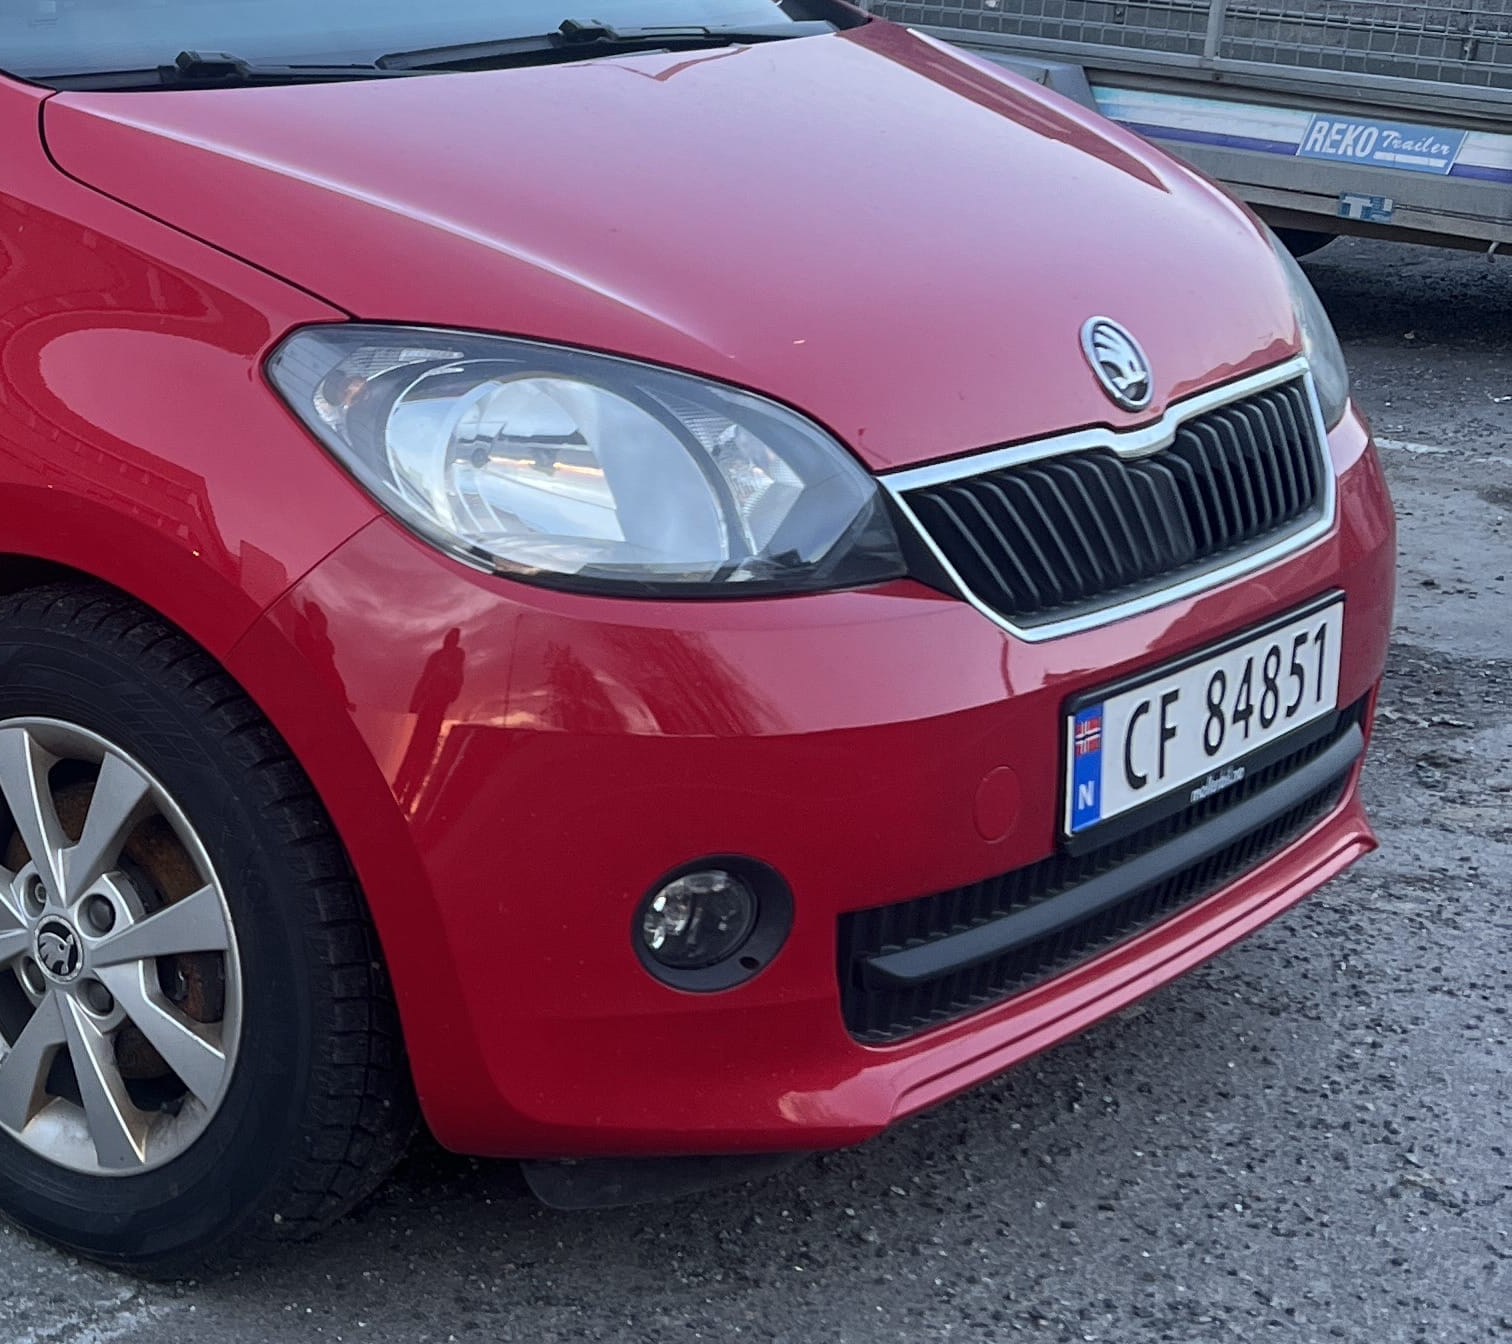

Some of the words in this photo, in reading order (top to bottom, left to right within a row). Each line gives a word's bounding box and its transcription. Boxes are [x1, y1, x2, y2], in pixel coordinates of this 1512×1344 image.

[1304, 121, 1379, 157] REKO
[1382, 130, 1450, 155] Trailer
[1124, 688, 1180, 790] CF
[1204, 622, 1327, 756] 84851
[1078, 780, 1095, 810] N
